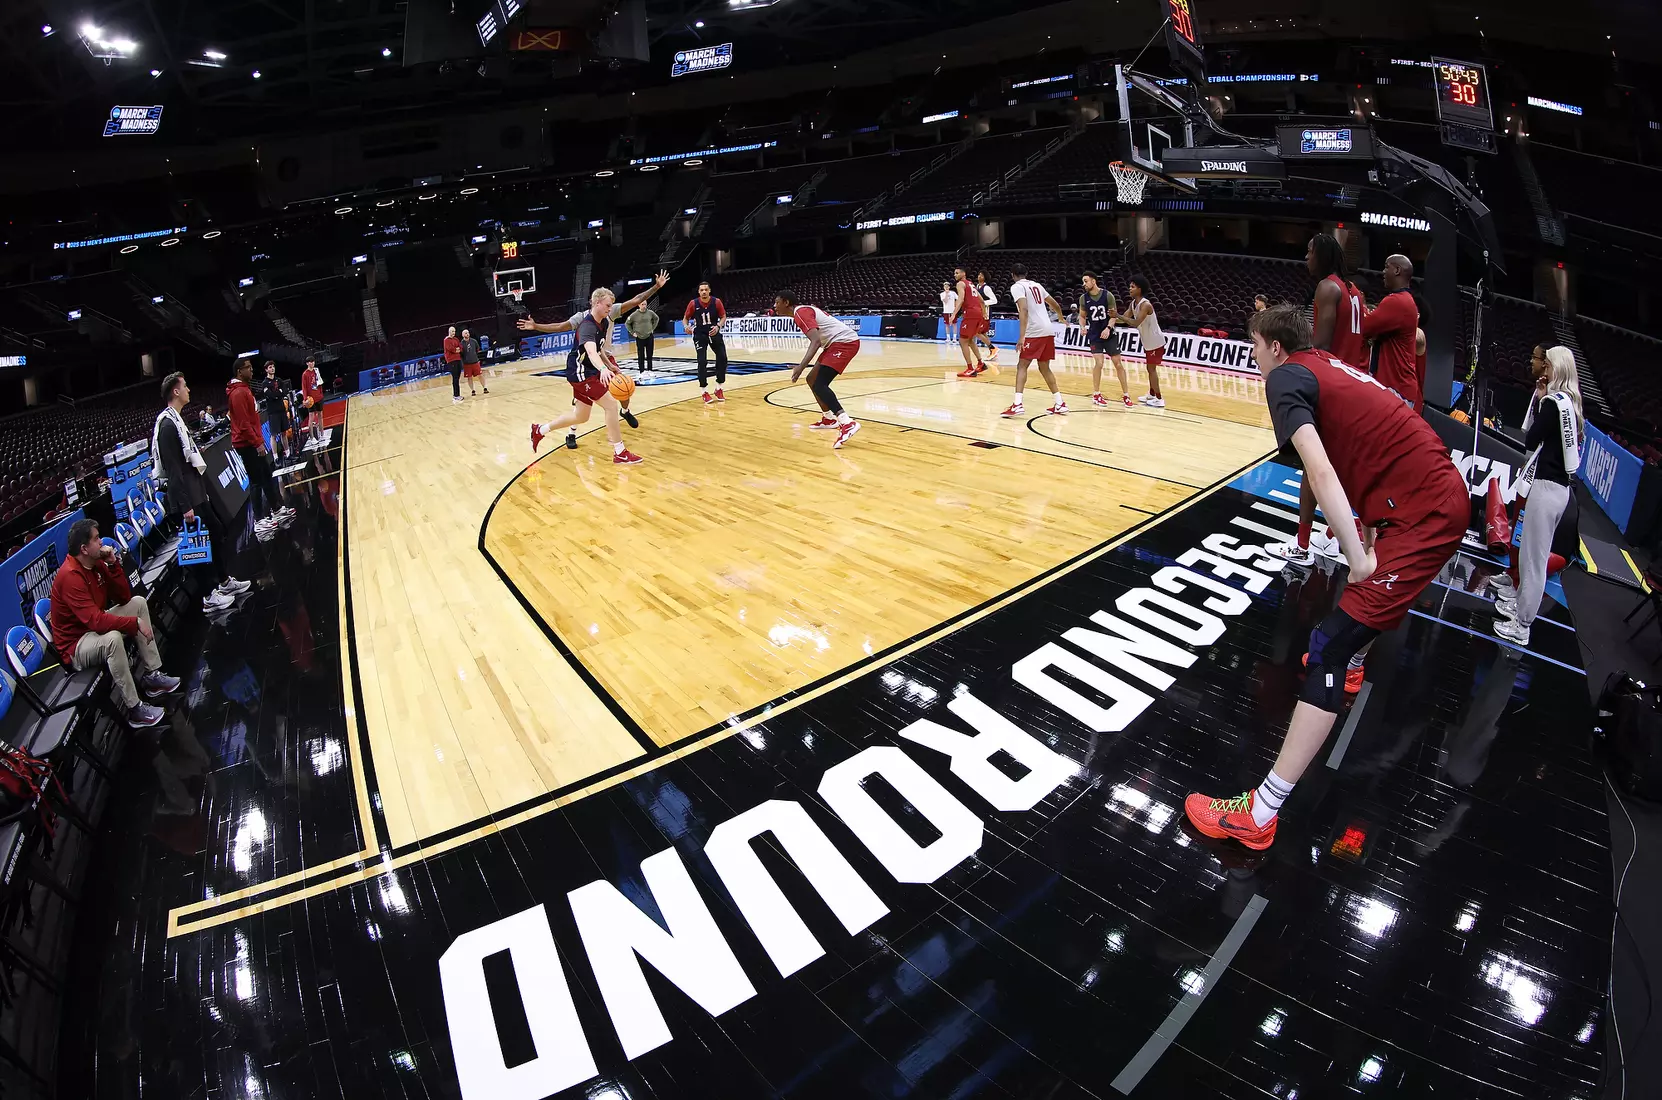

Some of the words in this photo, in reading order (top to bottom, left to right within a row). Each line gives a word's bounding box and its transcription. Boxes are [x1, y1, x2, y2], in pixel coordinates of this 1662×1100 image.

[1169, 0, 1194, 42] 30
[685, 48, 715, 61] MARCH
[689, 54, 730, 69] MADNESS
[1208, 75, 1234, 83] ETBALL
[1235, 74, 1296, 82] CHAMPIONSHIP
[1441, 65, 1479, 85] 50:43
[1451, 82, 1476, 104] 30
[119, 108, 149, 119] MARCH
[120, 119, 158, 130] MADNESS
[1311, 131, 1337, 140] MARCH
[686, 149, 719, 158] BASKETBALL
[719, 143, 762, 153] CHAMPIONSHIP
[1315, 140, 1350, 149] MADNESS
[1201, 160, 1247, 173] SPALDING
[863, 220, 882, 229] FIRST
[888, 215, 916, 226] SECOND
[103, 234, 133, 244] BASKETBALL
[133, 229, 173, 239] CHAMPIONSHIP
[503, 248, 517, 258] 30
[1029, 286, 1042, 304] 10
[701, 312, 711, 325] 11
[1089, 305, 1107, 321] 23
[739, 317, 768, 333] SECOND
[1585, 437, 1619, 503] MARCH
[24, 556, 50, 590] MARCH
[1012, 533, 1288, 733] SECOND
[438, 693, 1085, 1100] ROUND
